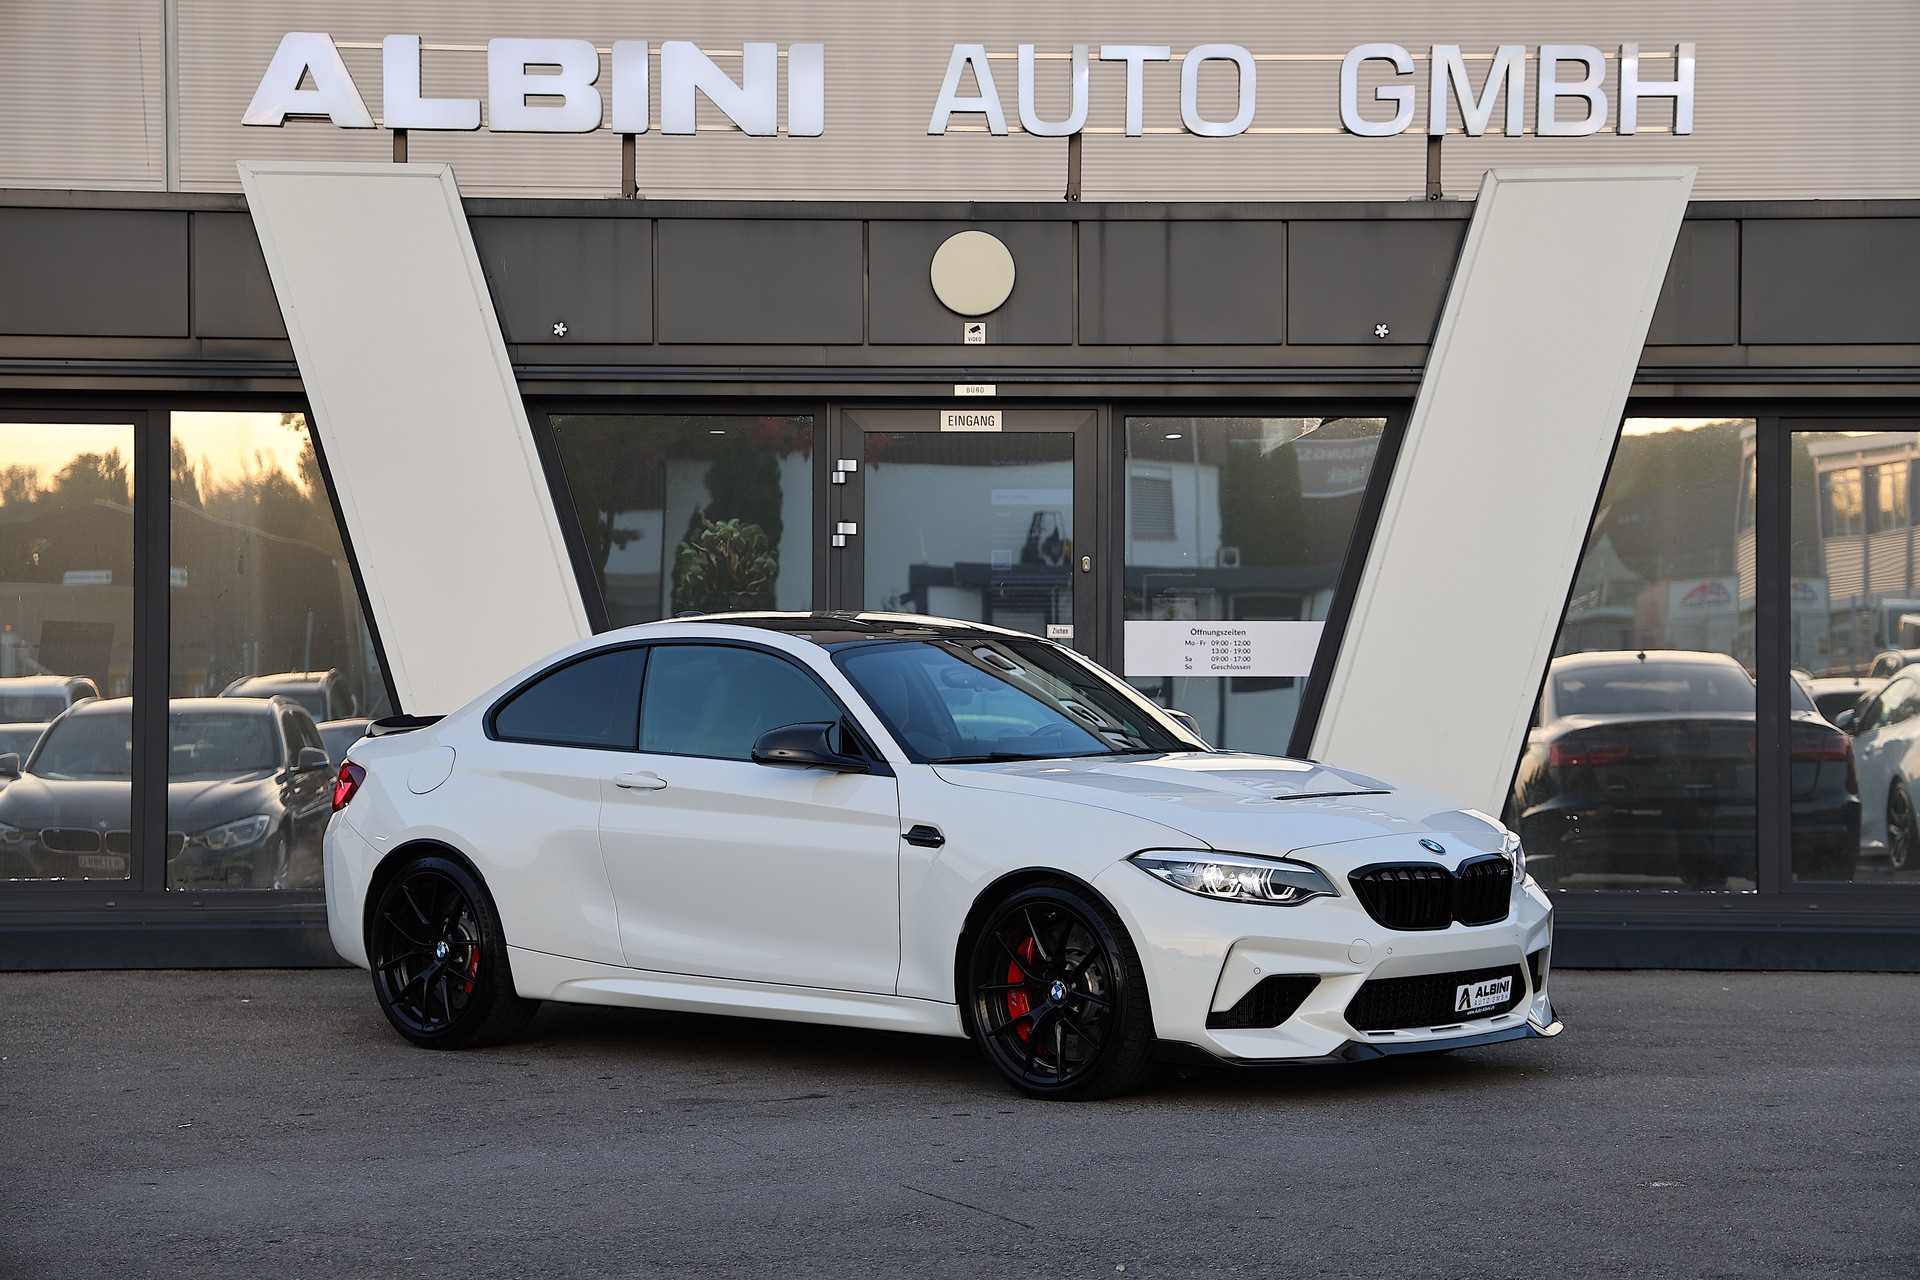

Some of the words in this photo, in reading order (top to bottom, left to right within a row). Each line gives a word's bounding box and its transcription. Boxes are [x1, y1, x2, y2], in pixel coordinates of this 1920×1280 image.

[241, 32, 825, 137] ALBINI
[927, 43, 1257, 137] AUTO
[1338, 43, 1697, 137] GMBH
[948, 415, 995, 427] EINGANG
[1190, 627, 1247, 637] Öffnungszeiten
[1475, 980, 1510, 998] ALBINI
[1474, 997, 1490, 1006] AUTO
[1492, 993, 1509, 1003] GMBH
